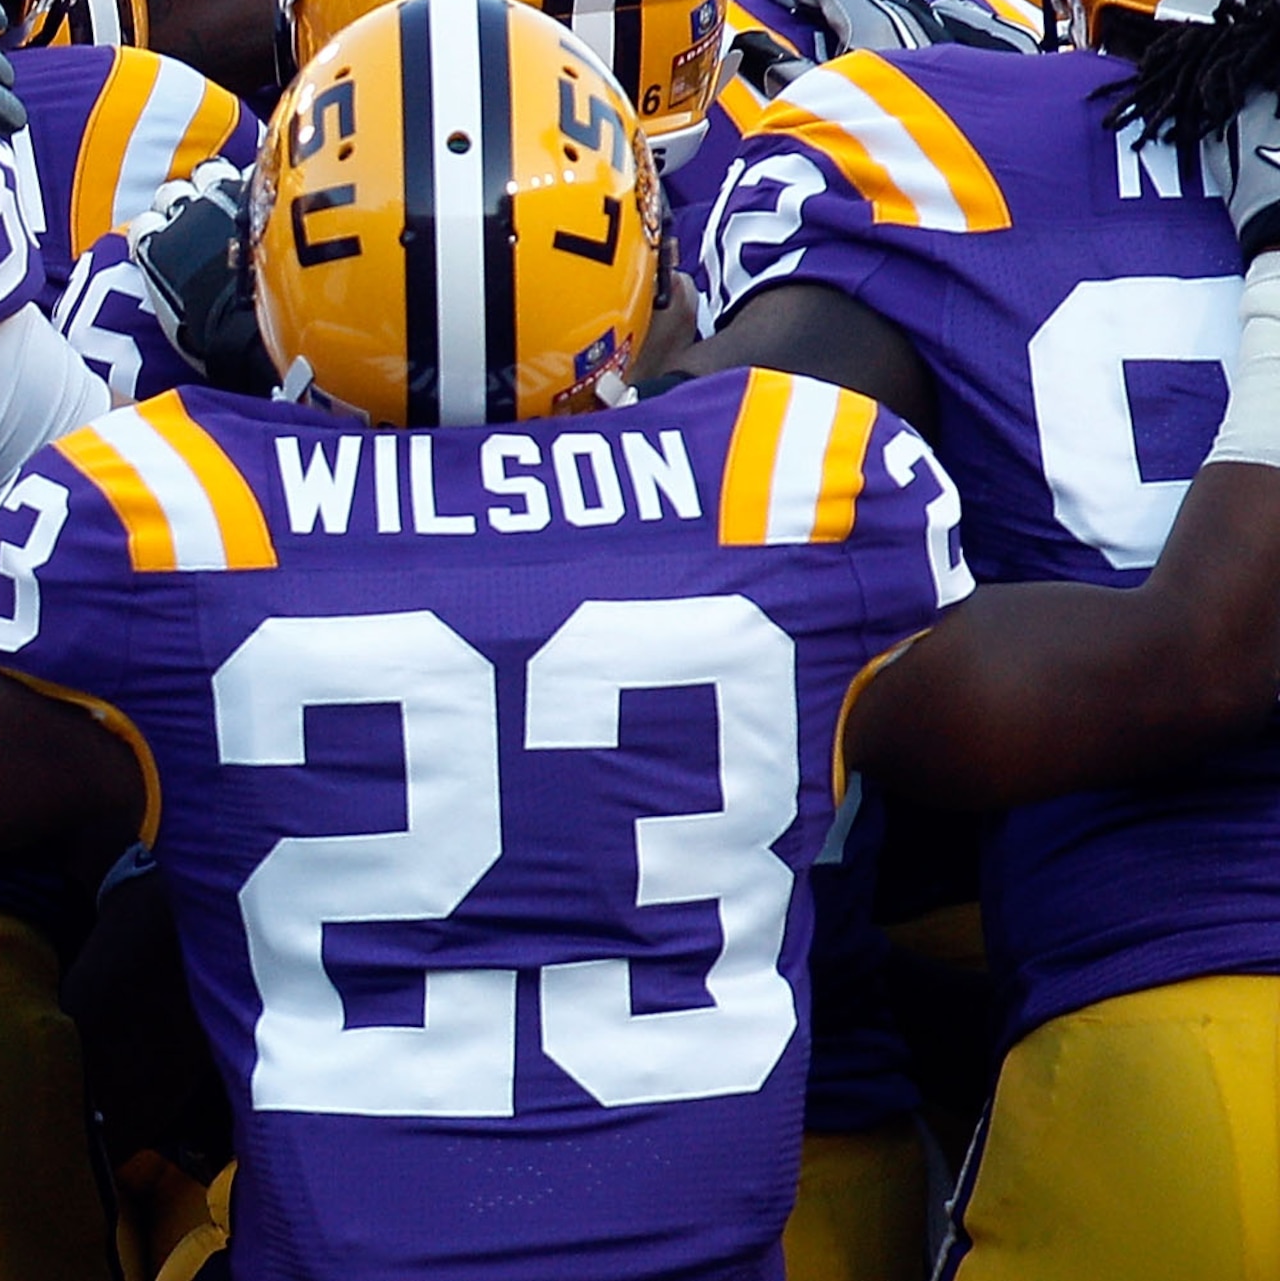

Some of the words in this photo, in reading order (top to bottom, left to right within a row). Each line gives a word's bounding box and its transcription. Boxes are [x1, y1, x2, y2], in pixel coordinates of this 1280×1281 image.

[642, 84, 662, 116] 6
[274, 430, 703, 536] WILSON
[212, 594, 802, 1118] 23
